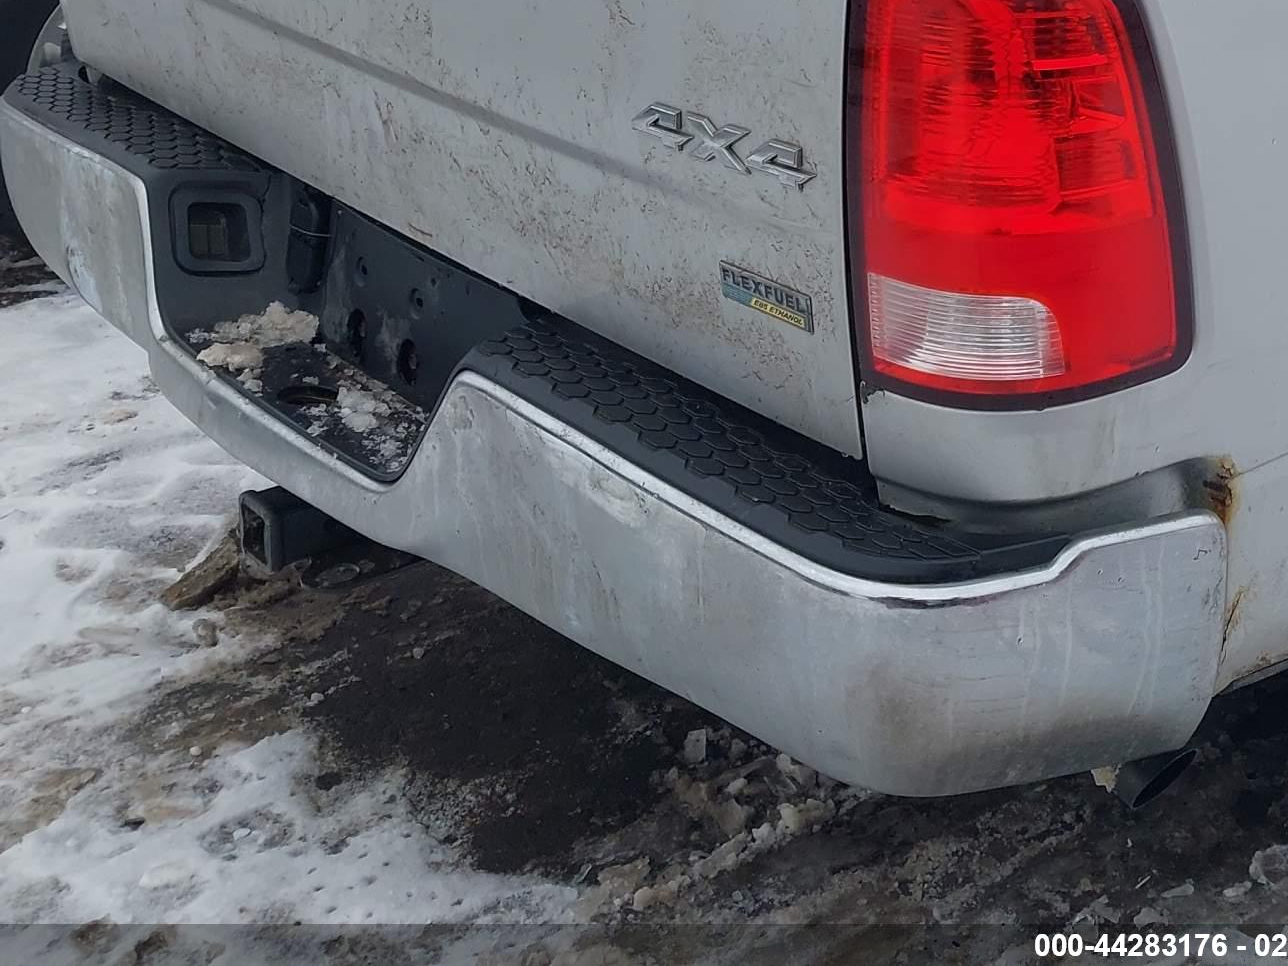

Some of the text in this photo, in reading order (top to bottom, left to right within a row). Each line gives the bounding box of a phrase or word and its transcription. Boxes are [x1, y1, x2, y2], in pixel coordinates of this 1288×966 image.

[721, 267, 807, 314] FLEXFUEL
[753, 299, 804, 326] E85 ETHANOL
